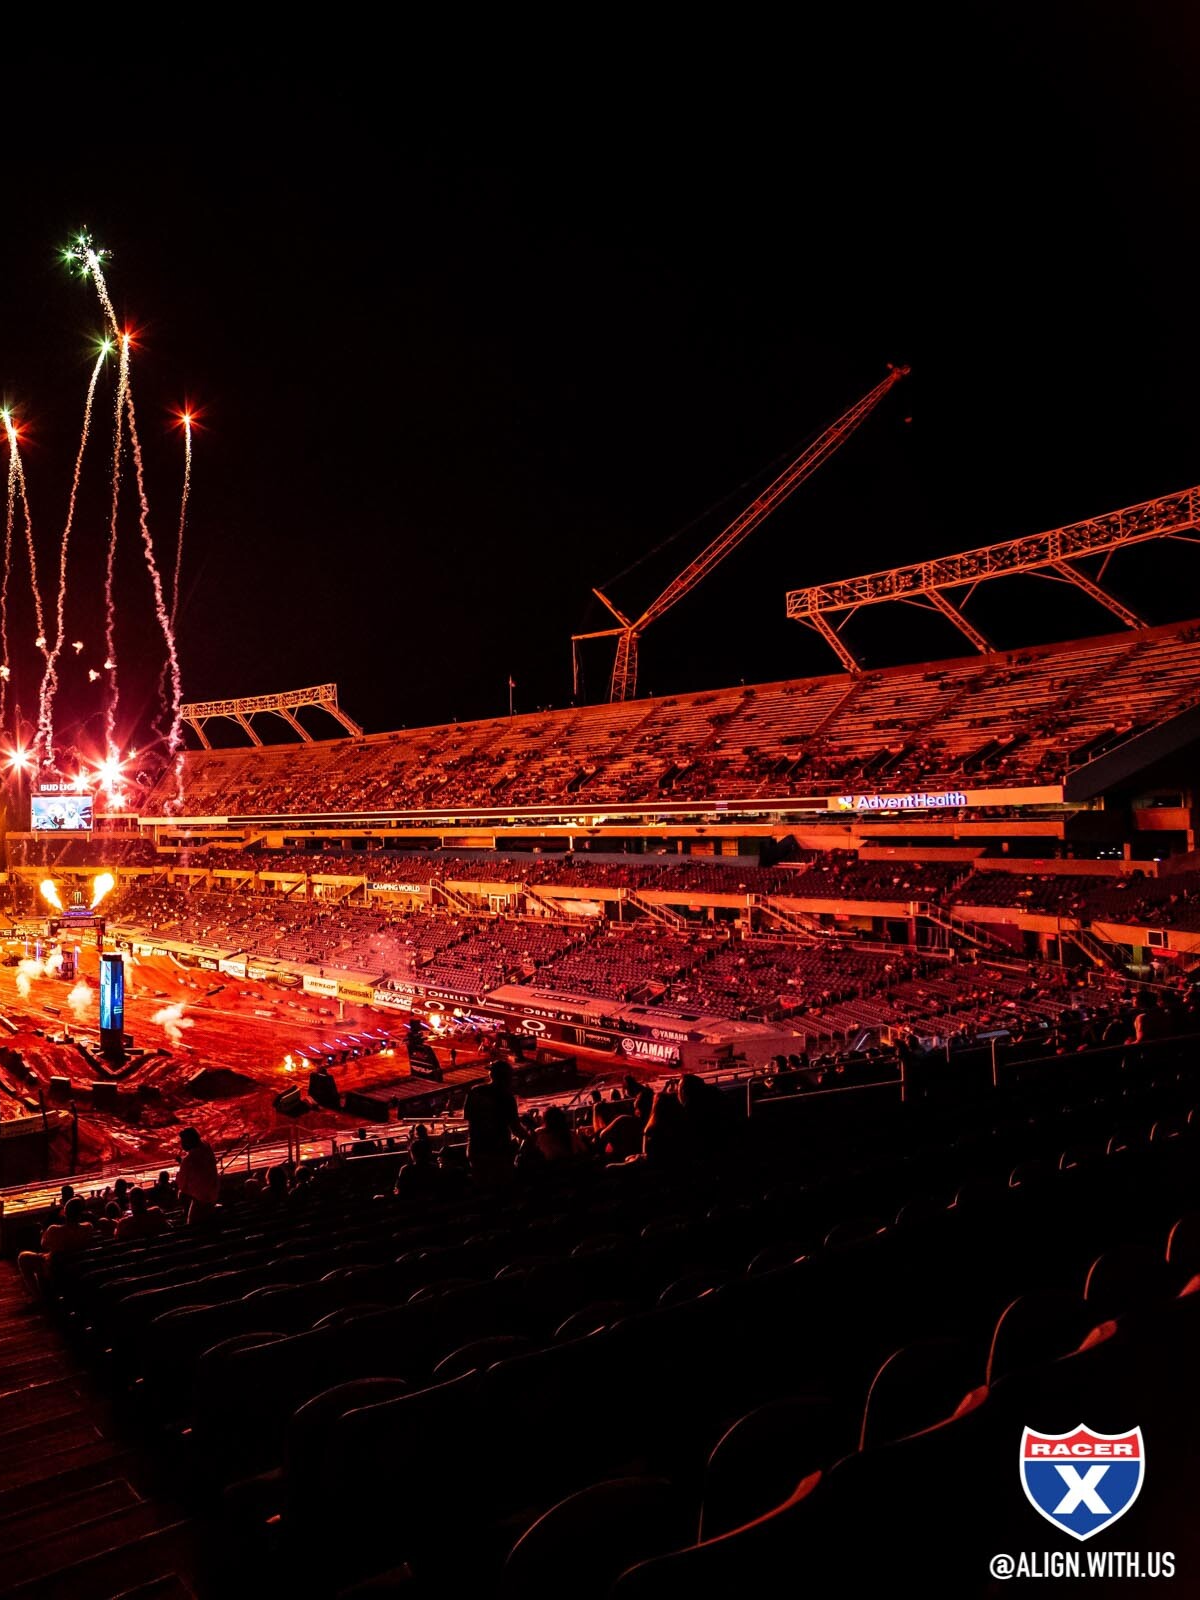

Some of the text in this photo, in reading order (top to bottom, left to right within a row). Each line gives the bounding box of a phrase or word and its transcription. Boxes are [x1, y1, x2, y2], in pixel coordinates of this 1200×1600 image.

[857, 792, 967, 809] AdventHealth
[373, 883, 420, 892] CAMPING WORLD
[308, 981, 335, 989] DUNLOP
[338, 985, 373, 999] Kawasaki
[439, 992, 470, 1002] OAKLEY
[516, 1027, 552, 1039] OAKLEY
[659, 1030, 688, 1041] YAMAHA
[635, 1042, 680, 1060] YAMAHA
